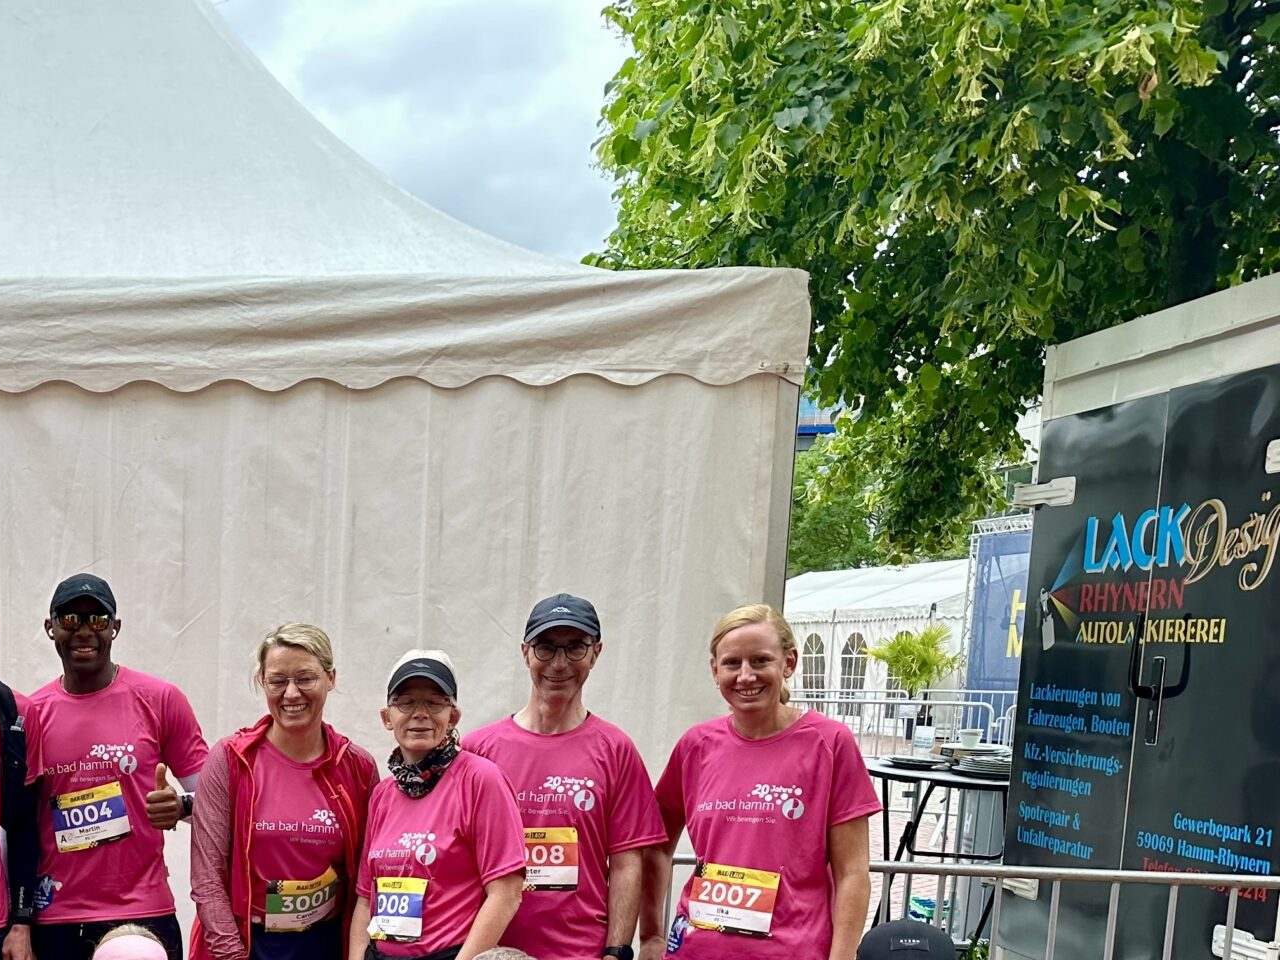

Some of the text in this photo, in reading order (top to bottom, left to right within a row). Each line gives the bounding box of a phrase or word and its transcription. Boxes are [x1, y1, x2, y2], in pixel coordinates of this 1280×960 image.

[1083, 502, 1192, 574] LACK
[1079, 577, 1187, 613] RHYNERN
[1075, 618, 1227, 644] AUTOLAKIEREREI
[1029, 683, 1121, 708] Lackierungen von
[1027, 708, 1131, 736] Fahrzeugen, Booten
[90, 744, 105, 756] 20
[1024, 742, 1124, 777] Kfz.-Versicherungs-
[56, 759, 113, 774] bad hamm
[544, 776, 562, 788] 20
[753, 784, 793, 797] 20 Jahre
[1022, 770, 1092, 797] regulierungen
[529, 791, 566, 803] hamm
[715, 799, 736, 811] bad
[738, 799, 774, 811] hamm
[62, 802, 113, 827] 1004
[312, 809, 329, 821] 20
[1019, 800, 1081, 831] Spotrepair &
[60, 834, 68, 843] A
[79, 825, 101, 834] Martin
[278, 821, 298, 832] bad
[301, 822, 335, 834] hamm
[1173, 812, 1273, 847] Gewerbepark 21
[385, 848, 411, 858] hamm
[1017, 825, 1094, 860] Unfallreparatur
[1136, 831, 1271, 875] 59069 Hamm-Rhynern
[525, 845, 565, 864] 08
[281, 886, 330, 912] 3001
[377, 894, 410, 914] 008
[698, 881, 762, 908] 2007
[716, 907, 730, 915] Ilka
